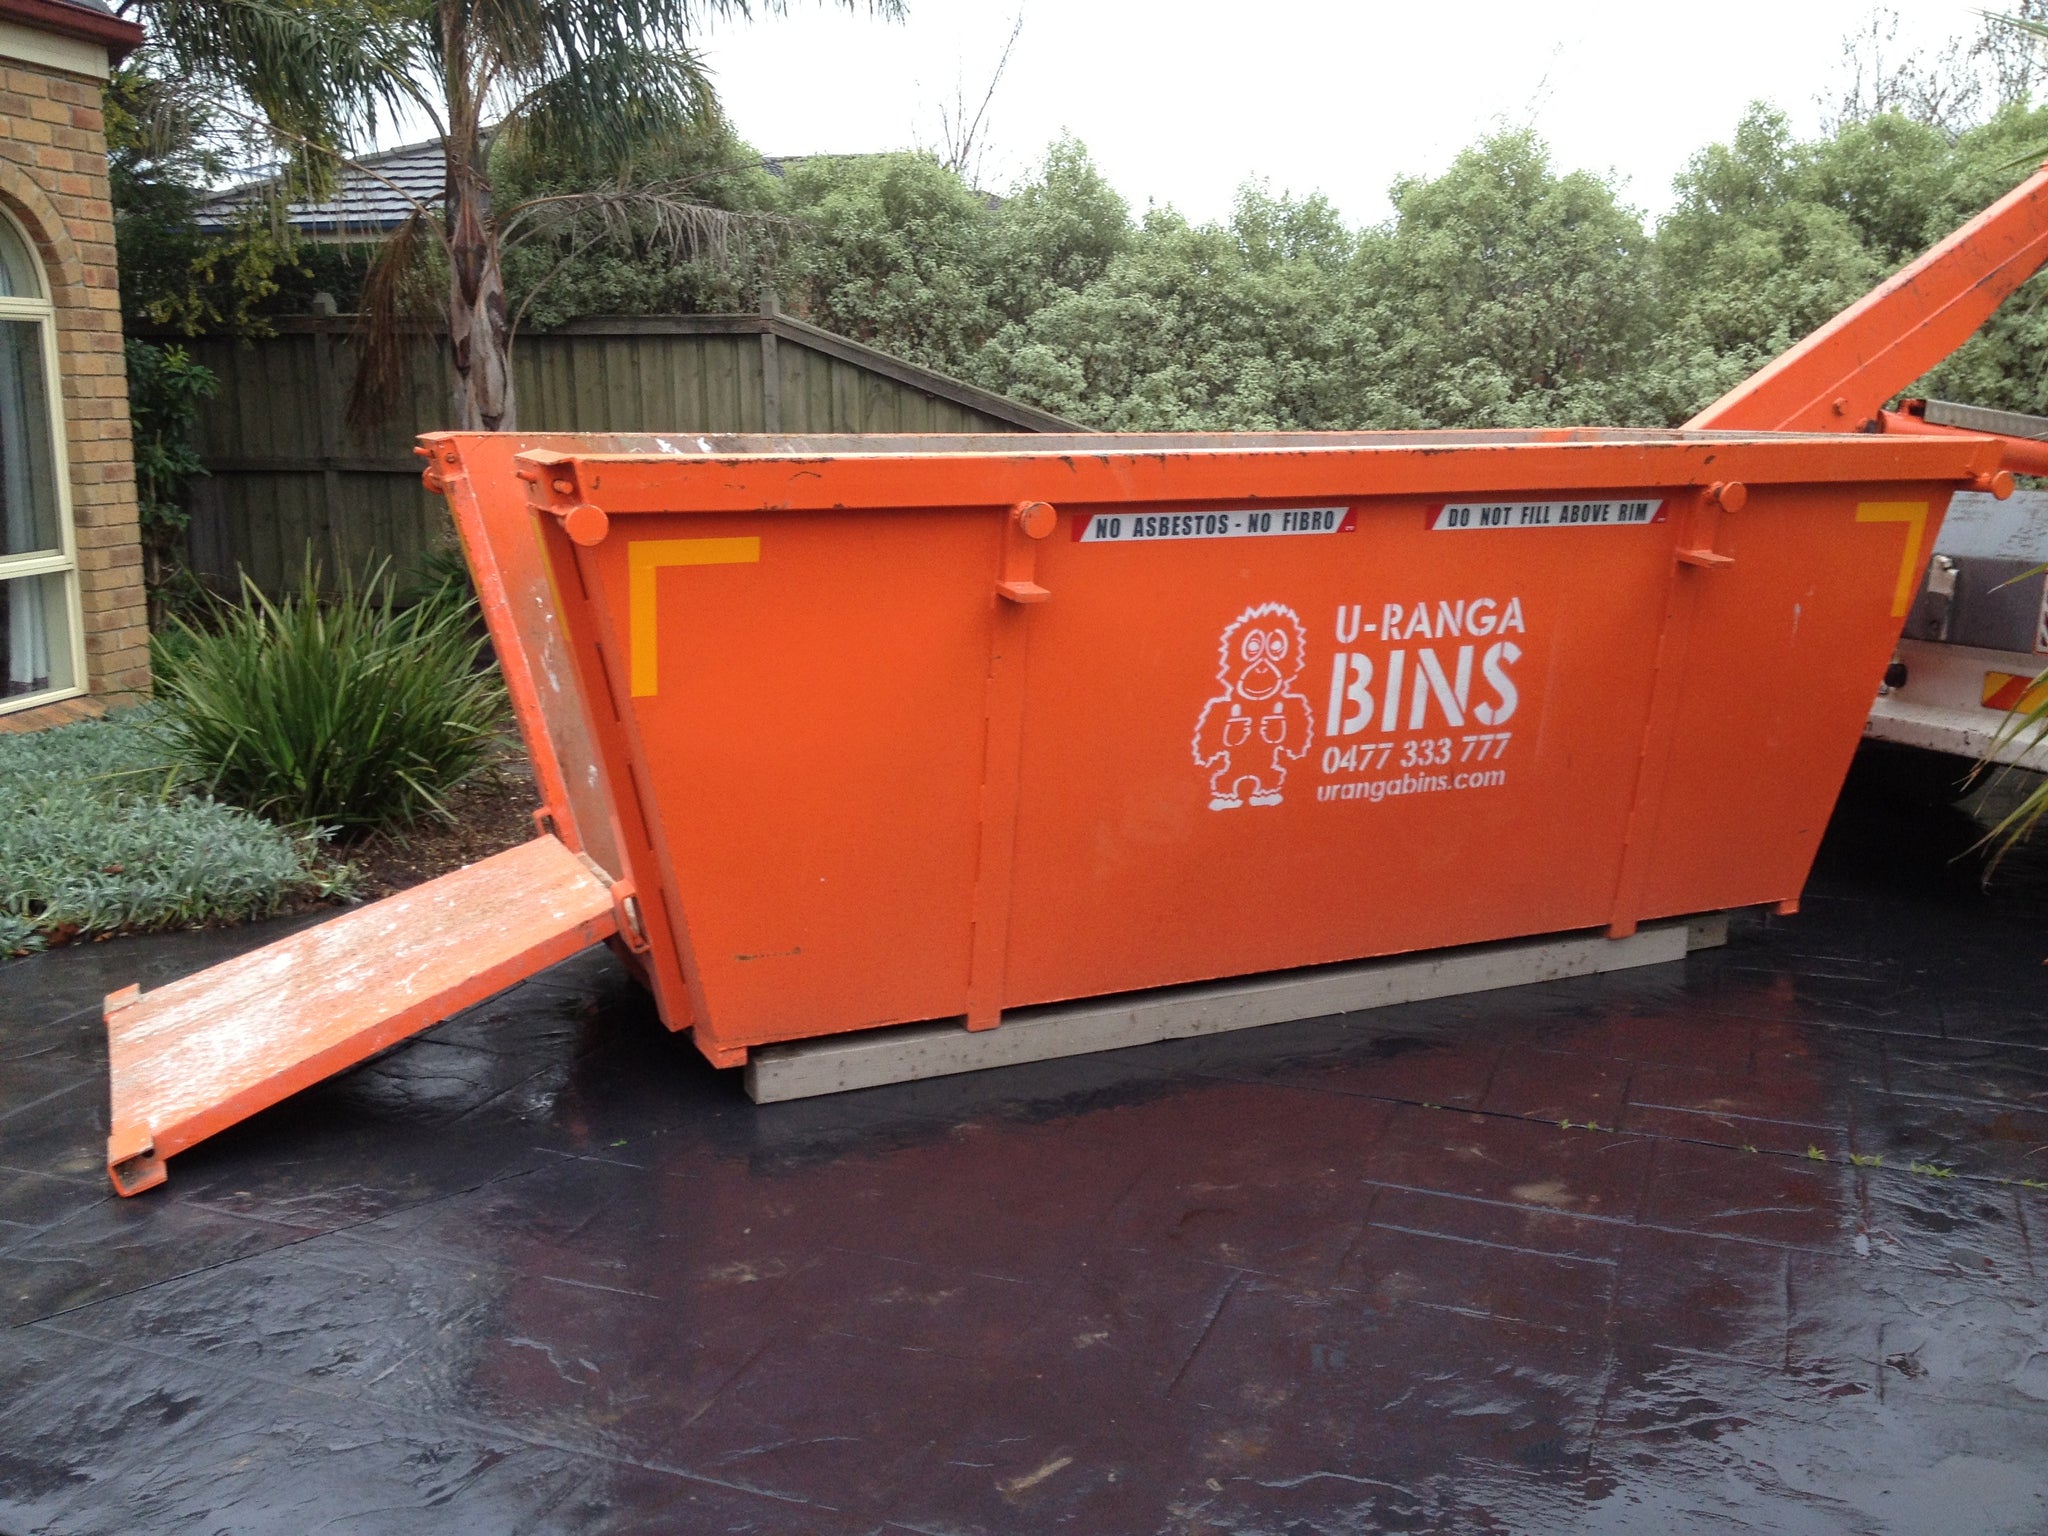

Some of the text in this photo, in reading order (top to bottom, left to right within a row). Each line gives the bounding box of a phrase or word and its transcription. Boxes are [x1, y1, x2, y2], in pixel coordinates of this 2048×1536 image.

[1095, 518, 1121, 539] NO
[1132, 514, 1229, 537] ASBESTOS
[1247, 513, 1271, 532] NO
[1282, 510, 1335, 531] FIBRO
[1448, 503, 1648, 527] DO NOT FILL ABOVE RIM
[1335, 597, 1526, 644] U-RANGA
[1326, 641, 1522, 737] BINS
[1322, 732, 1512, 774] 0477 333 777
[1317, 770, 1506, 803] urangabins.com
